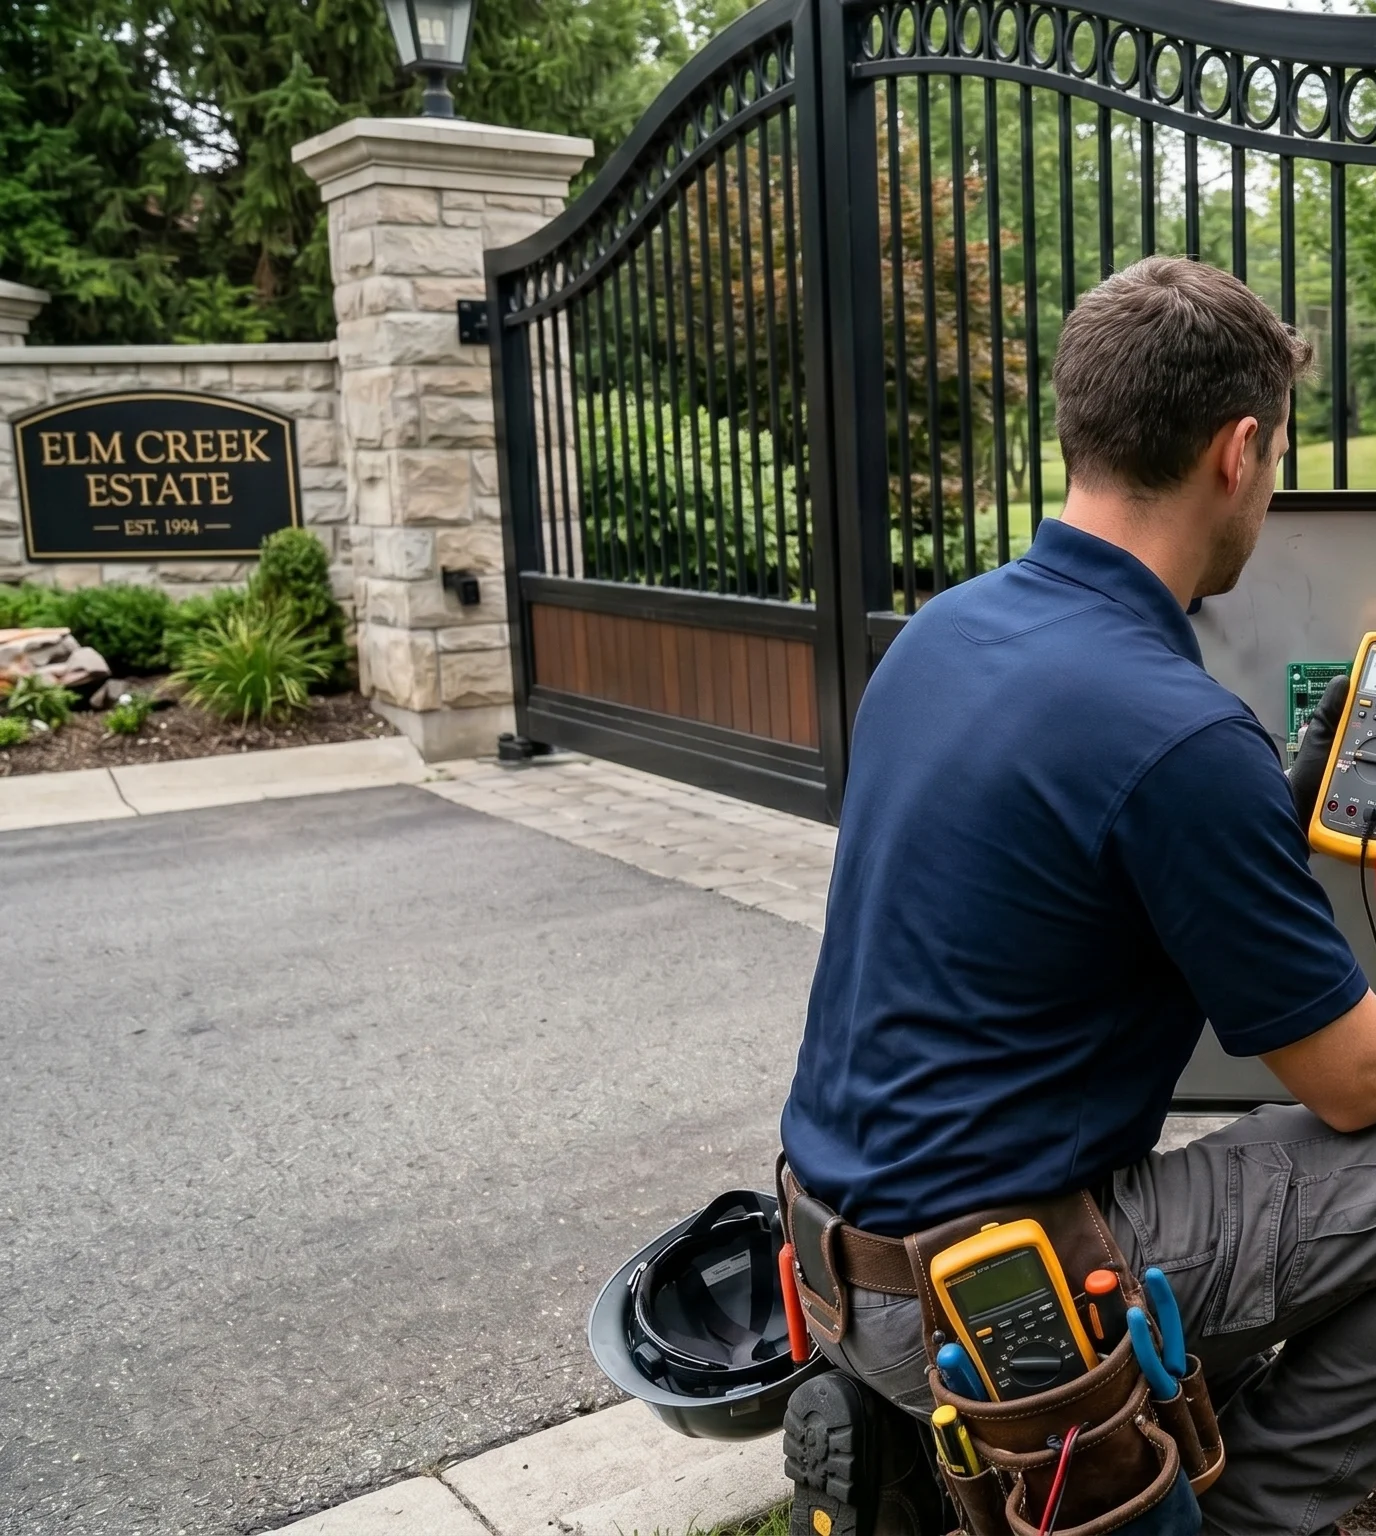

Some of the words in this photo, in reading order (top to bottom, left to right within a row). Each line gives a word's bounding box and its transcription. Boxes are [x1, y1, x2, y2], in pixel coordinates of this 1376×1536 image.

[39, 431, 126, 466] ELM
[135, 429, 272, 464] CREEK
[85, 472, 234, 507] ESTATE
[124, 519, 160, 536] EST.
[165, 519, 199, 535] 1994
